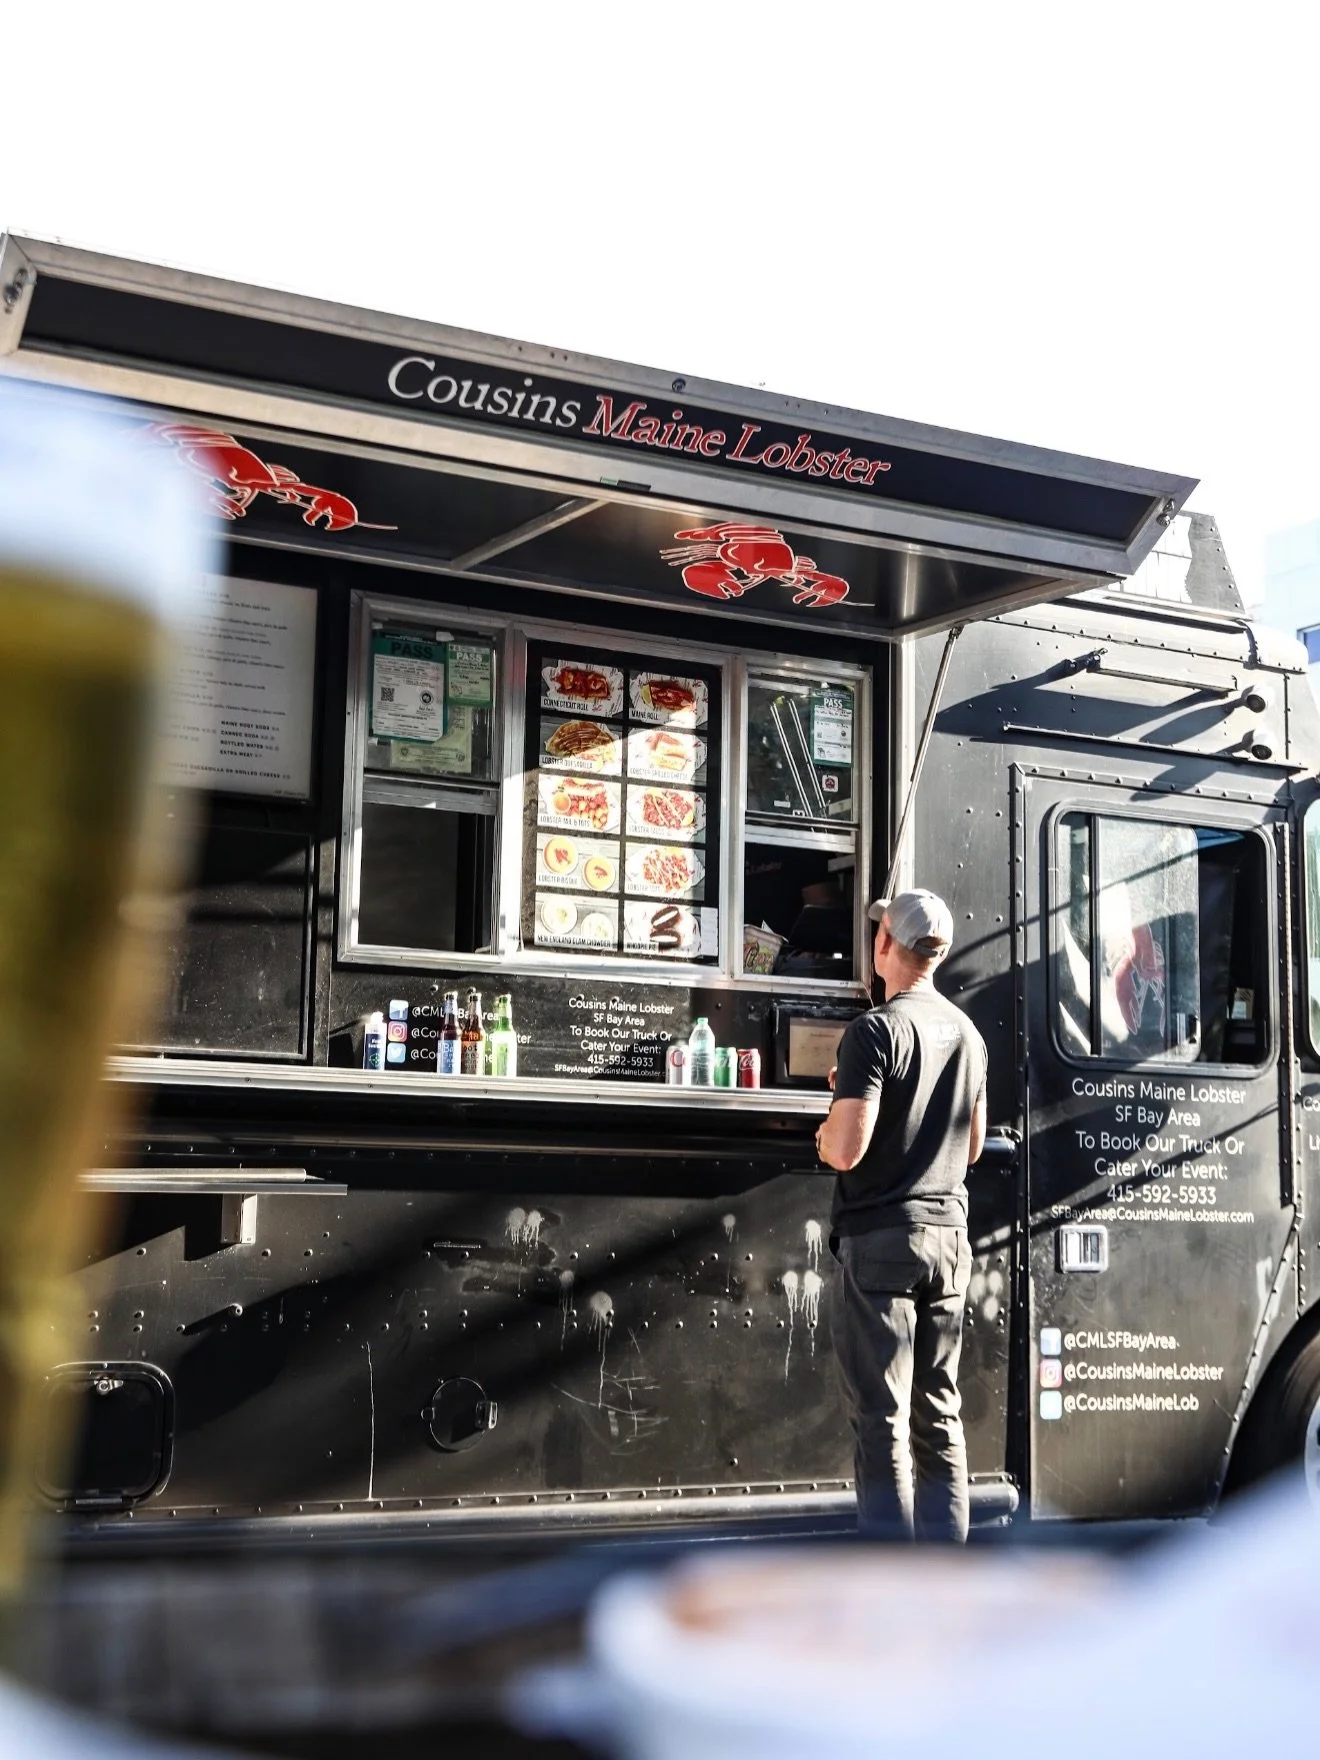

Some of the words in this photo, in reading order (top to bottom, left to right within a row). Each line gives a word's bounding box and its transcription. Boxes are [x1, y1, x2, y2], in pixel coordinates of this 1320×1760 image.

[387, 355, 582, 428] Cousins
[582, 395, 727, 456] Maine
[726, 422, 891, 486] Lobster
[390, 642, 433, 659] PASS
[456, 652, 483, 662] PASS
[543, 698, 576, 709] CONNECTICUT
[577, 703, 588, 711] ROLL
[823, 697, 843, 709] PASS
[631, 710, 646, 719] MAINE
[647, 712, 658, 720] ROLL
[542, 756, 563, 765] LOBSTER
[568, 997, 607, 1011] Cousins
[609, 999, 637, 1012] Maine
[639, 1002, 675, 1015] Lobster
[593, 1013, 604, 1023] SF
[607, 1015, 624, 1027] Bay
[624, 1017, 645, 1027] Area
[569, 1025, 582, 1036] To
[584, 1027, 610, 1038] Book
[612, 1029, 630, 1039] Our
[632, 1030, 658, 1041] Truck
[659, 1031, 673, 1042] Or
[580, 1040, 608, 1051] Cater
[609, 1041, 631, 1053] Your
[633, 1043, 662, 1055] Event:
[587, 1053, 655, 1068] 415-592-5933
[1071, 1078, 1135, 1098] Cousins
[1139, 1081, 1186, 1100] Maine
[1190, 1083, 1247, 1104] Lobster
[1114, 1104, 1132, 1122] SF
[1137, 1106, 1164, 1128] Bay
[1167, 1107, 1201, 1127] Area
[1075, 1130, 1095, 1149] To
[1100, 1131, 1141, 1151] Book
[1145, 1134, 1176, 1152] Our
[1179, 1134, 1222, 1154] Truck
[1224, 1136, 1245, 1155] Or
[1094, 1157, 1138, 1177] Cater
[1141, 1159, 1177, 1178] Your
[1181, 1160, 1228, 1180] Event:
[1107, 1184, 1217, 1205] 415-592-5933
[1051, 1205, 1255, 1224] SFBayArea@CousinsMaineLobster.com
[1063, 1331, 1176, 1352] @CMLSFBayArea
[1063, 1361, 1225, 1381] @CousinsMaineLobster
[1063, 1392, 1200, 1413] @CousinsMaineLob
